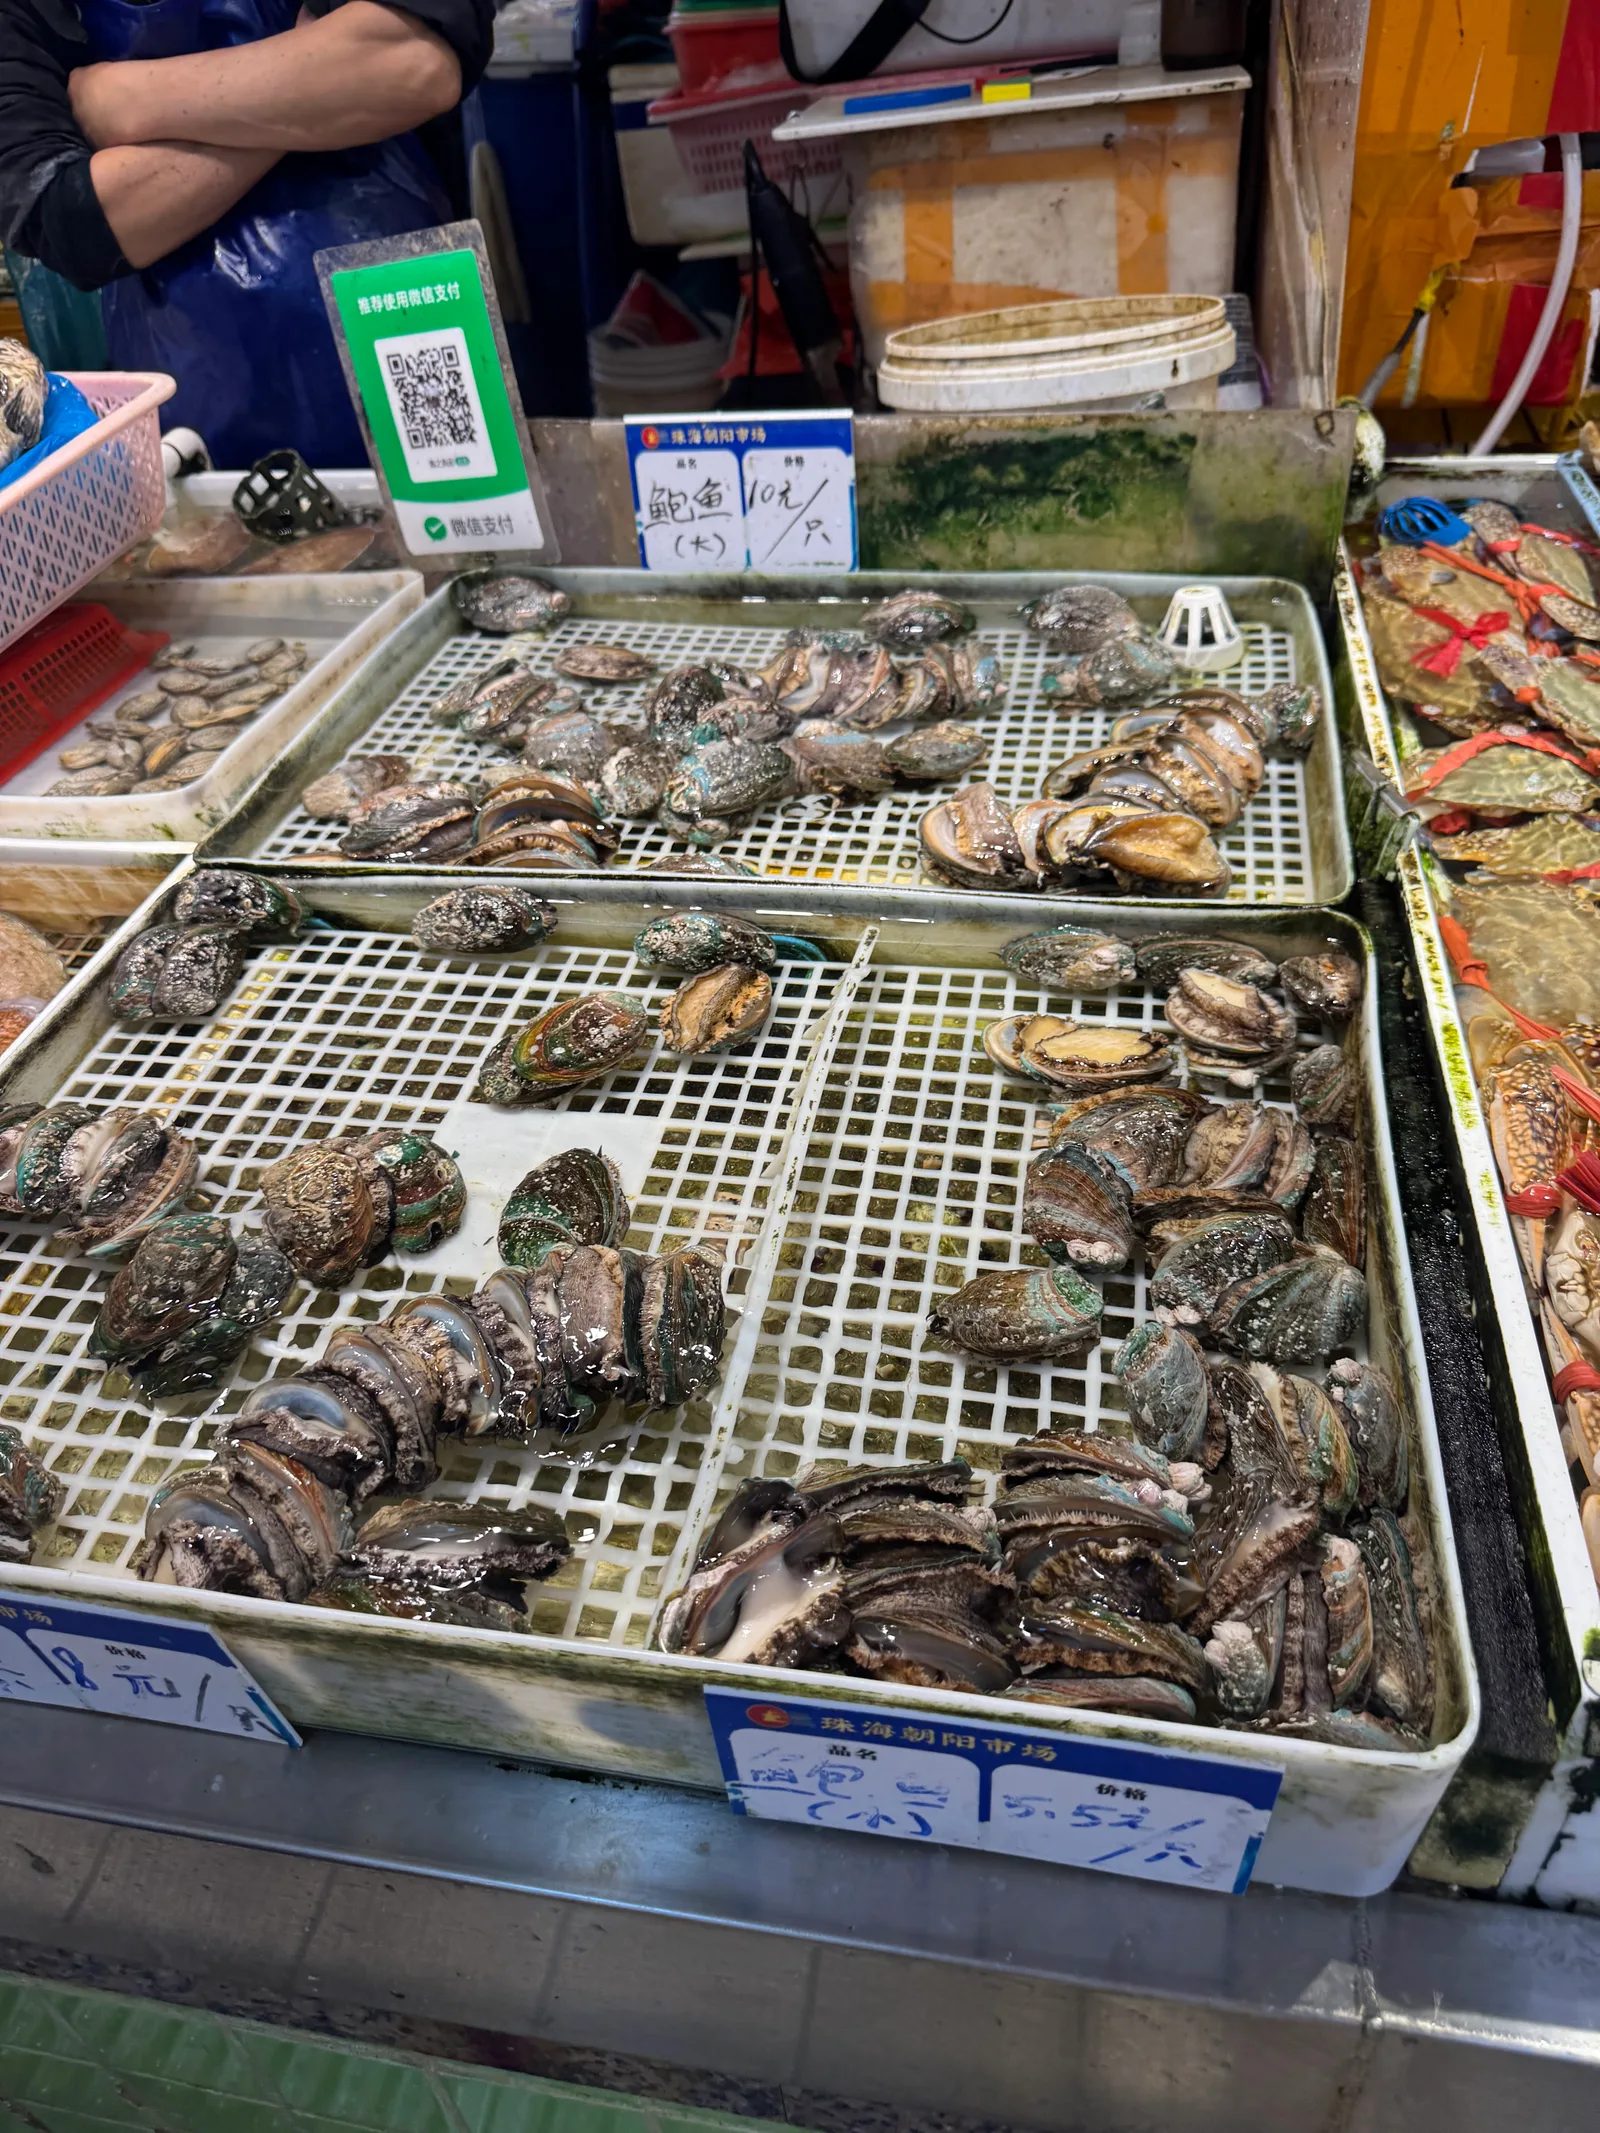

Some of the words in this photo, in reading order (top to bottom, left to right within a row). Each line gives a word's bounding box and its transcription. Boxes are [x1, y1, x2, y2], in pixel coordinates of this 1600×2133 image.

[357, 281, 461, 315] 推荐使用微信支付
[671, 426, 767, 445] 珠海朝阳市场
[676, 457, 697, 470] 品名
[645, 477, 733, 530] 鲍鱼
[451, 515, 515, 537] 微信支付
[819, 1716, 1058, 1763] 珠海朝阳市场
[828, 1744, 878, 1762] 品名
[1095, 1782, 1148, 1801] 价格
